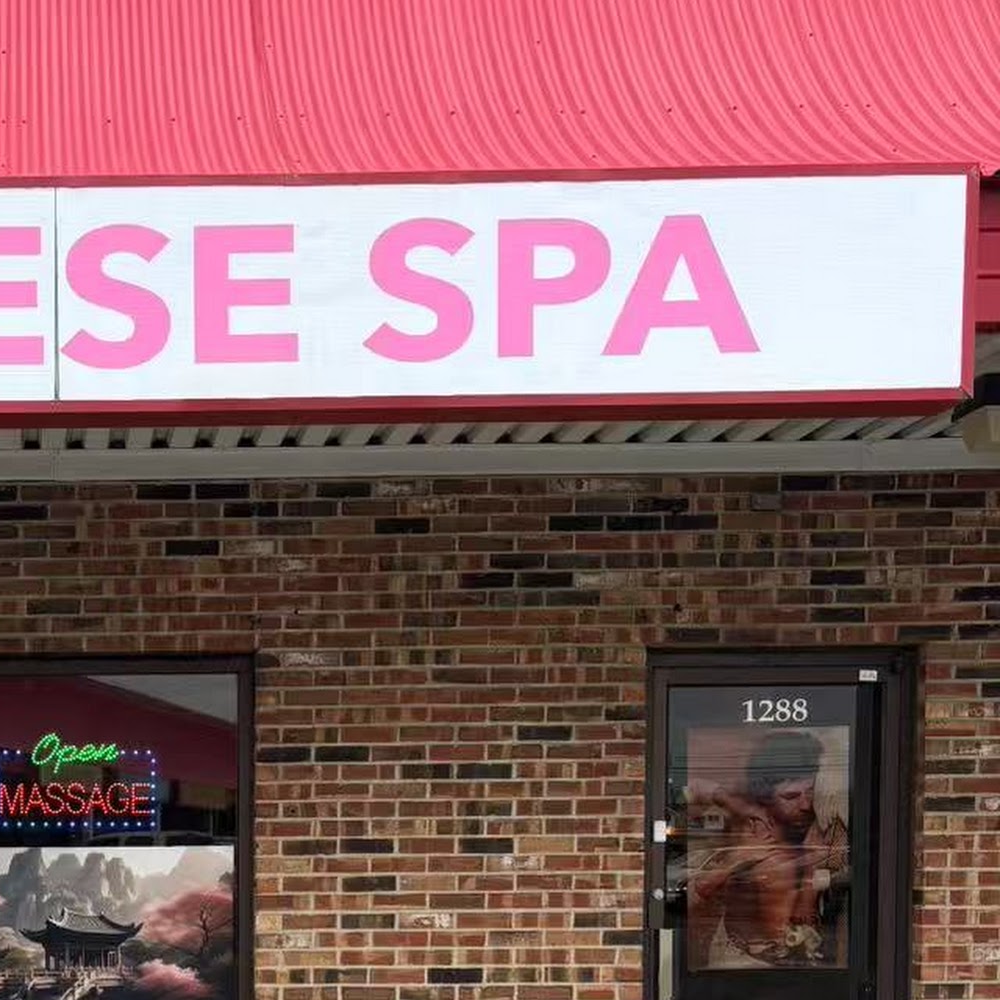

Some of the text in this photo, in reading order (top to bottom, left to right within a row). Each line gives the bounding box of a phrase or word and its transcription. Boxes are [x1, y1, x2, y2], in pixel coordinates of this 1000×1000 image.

[363, 214, 760, 363] SPA
[743, 699, 808, 722] 1288
[31, 733, 119, 773] Open
[0, 783, 151, 815] MASSAGE
